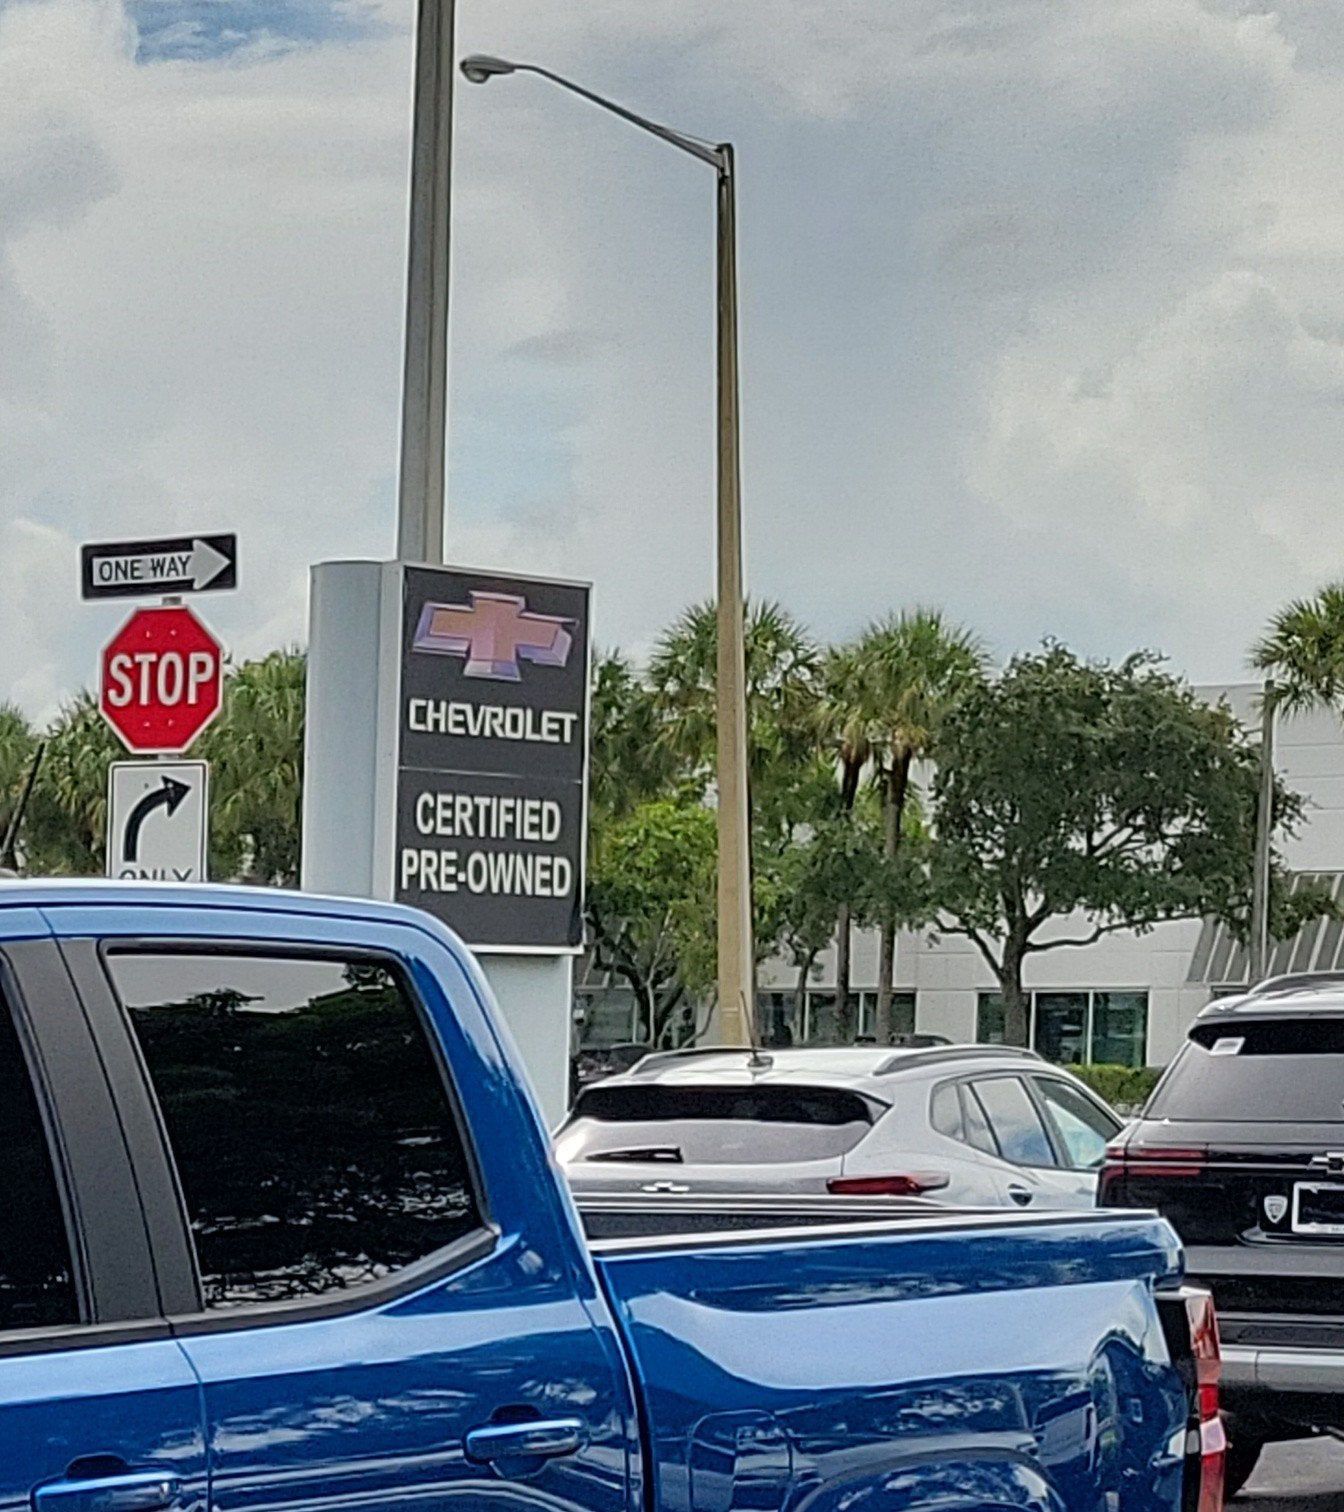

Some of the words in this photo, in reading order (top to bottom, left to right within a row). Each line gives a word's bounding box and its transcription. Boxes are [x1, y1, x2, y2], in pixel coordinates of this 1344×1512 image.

[99, 559, 144, 582] ONE
[150, 555, 192, 577] WAY
[108, 652, 215, 707] STOP
[408, 698, 578, 743] CHEVROLET
[416, 793, 561, 841] CERTIFIED
[401, 848, 572, 897] PRE-OWNED
